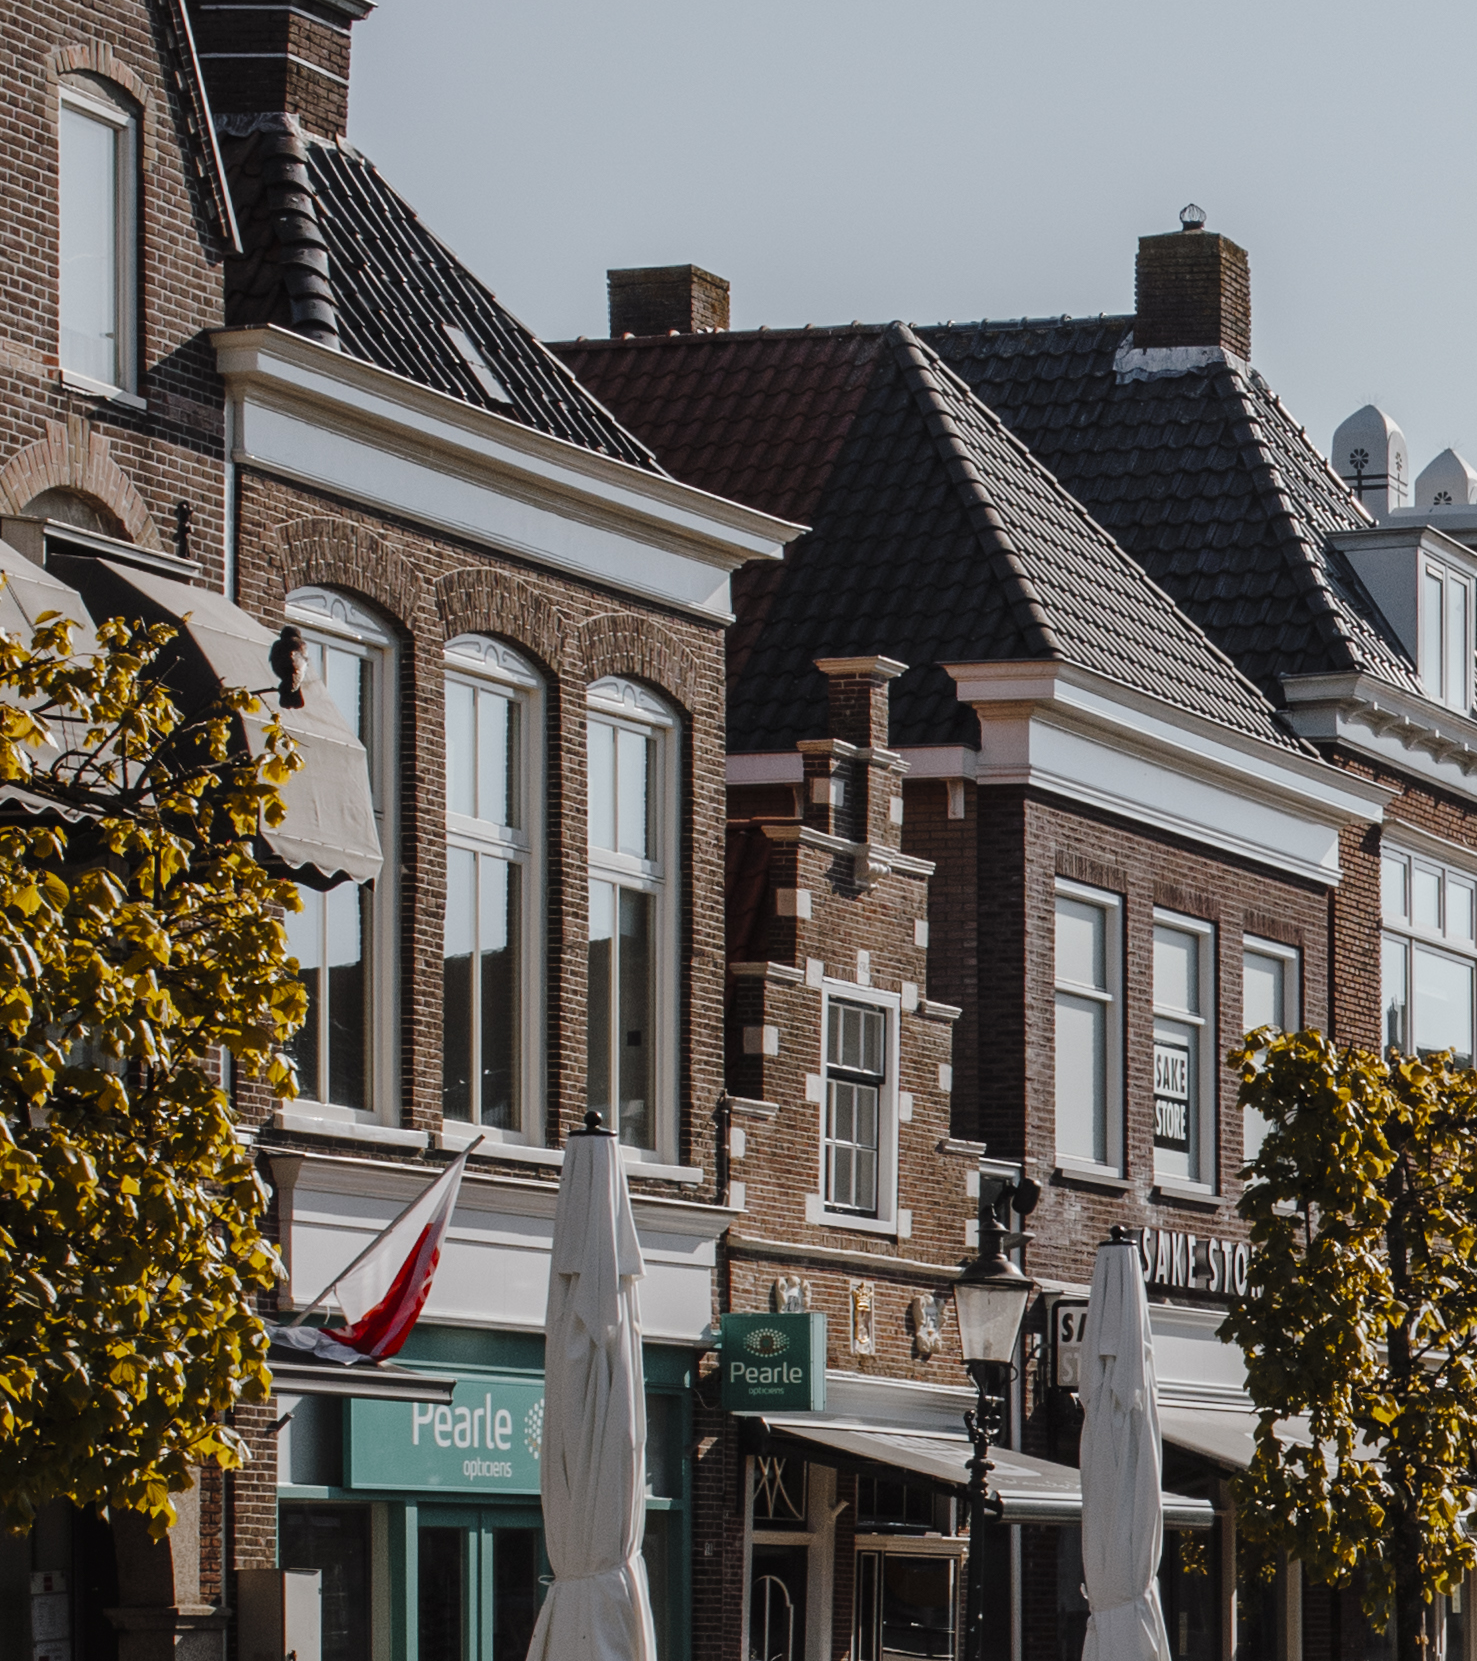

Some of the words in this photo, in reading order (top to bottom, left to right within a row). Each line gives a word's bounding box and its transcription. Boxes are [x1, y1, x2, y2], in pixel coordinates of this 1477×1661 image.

[1156, 1054, 1186, 1094] SAKE
[1155, 1099, 1186, 1140] STORE
[1141, 1226, 1197, 1288] SAKE
[1208, 1237, 1264, 1299] STO
[730, 1361, 803, 1384] Pearle
[748, 1386, 785, 1396] opticiens
[412, 1392, 513, 1450] Pearle
[463, 1457, 513, 1481] opticiens
